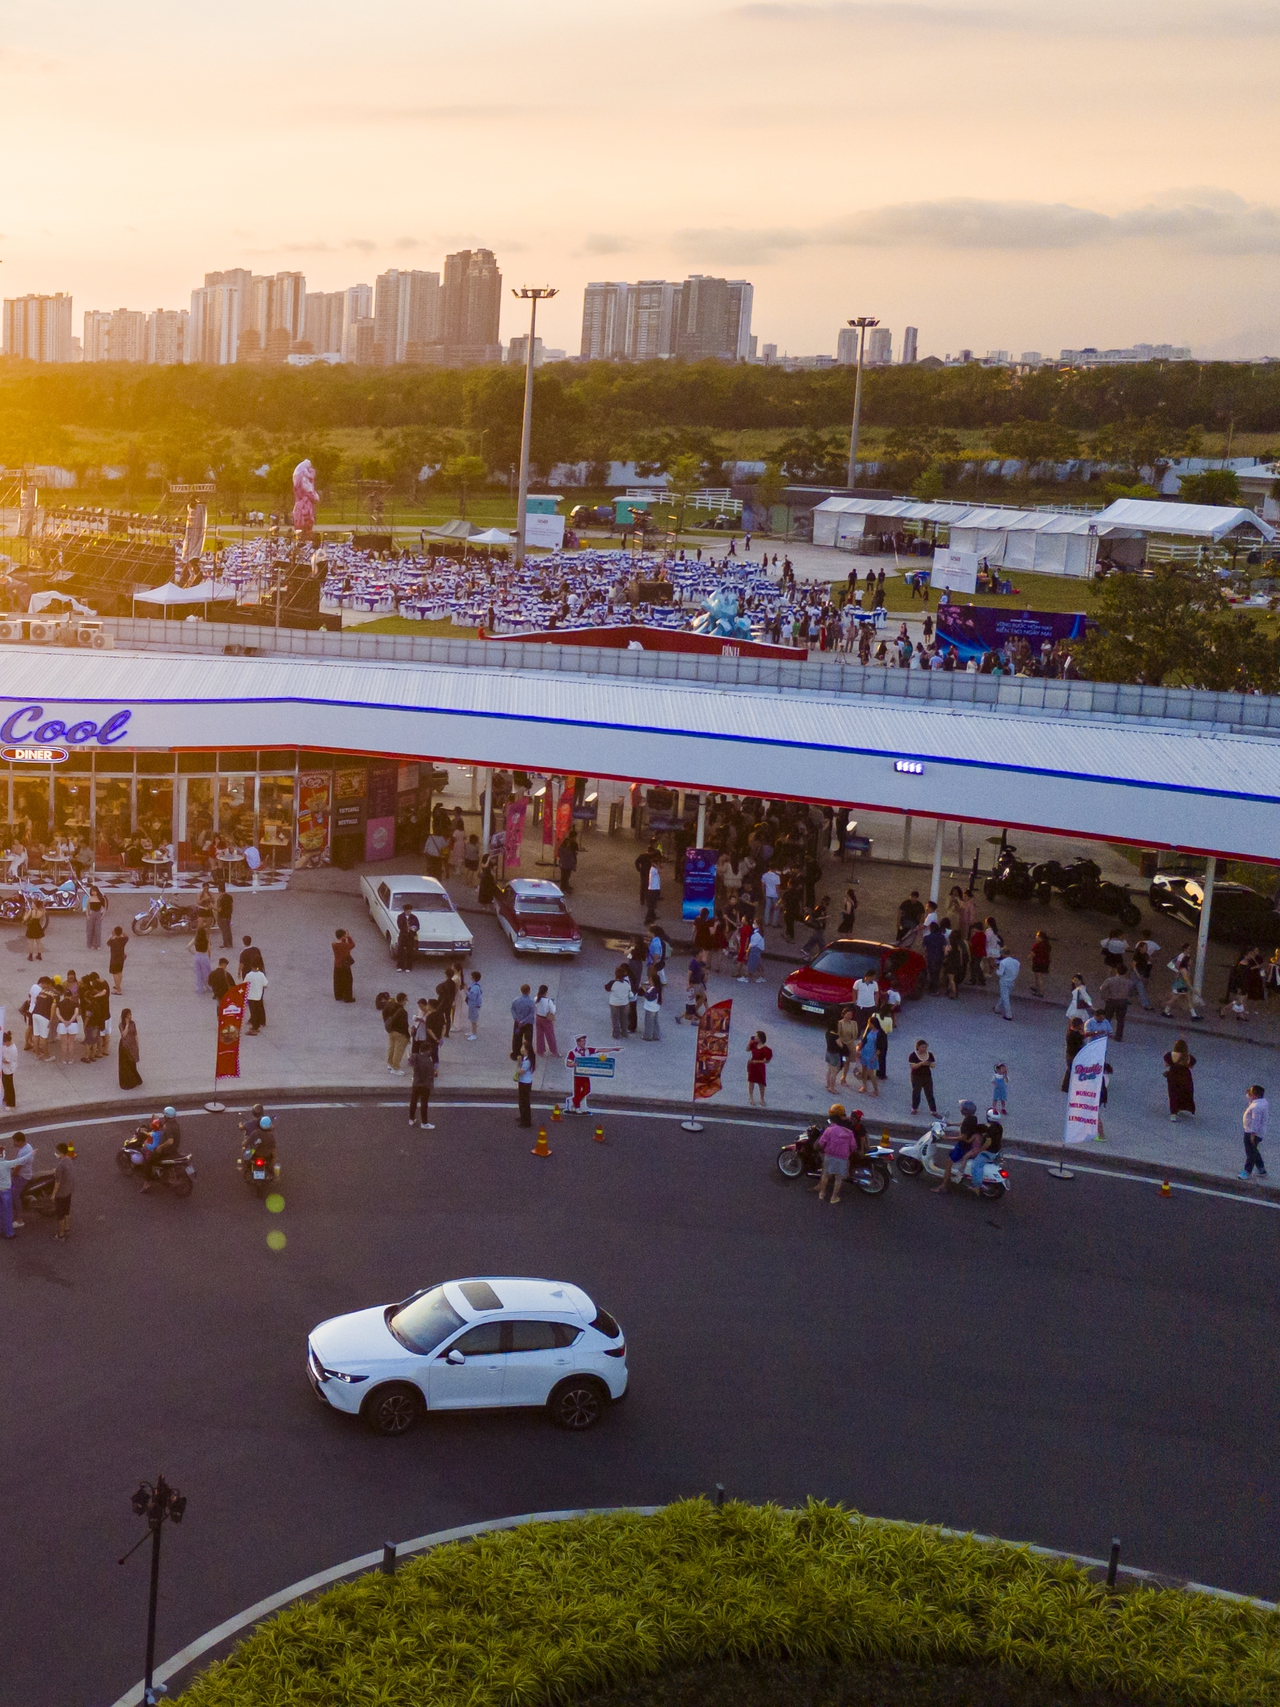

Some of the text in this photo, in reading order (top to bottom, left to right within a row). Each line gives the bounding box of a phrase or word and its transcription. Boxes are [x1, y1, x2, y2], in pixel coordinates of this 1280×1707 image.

[0, 705, 132, 745] Cool
[15, 749, 52, 760] DINER
[1075, 1090, 1096, 1098] BURGER
[1068, 1115, 1096, 1125] LEMONADE
